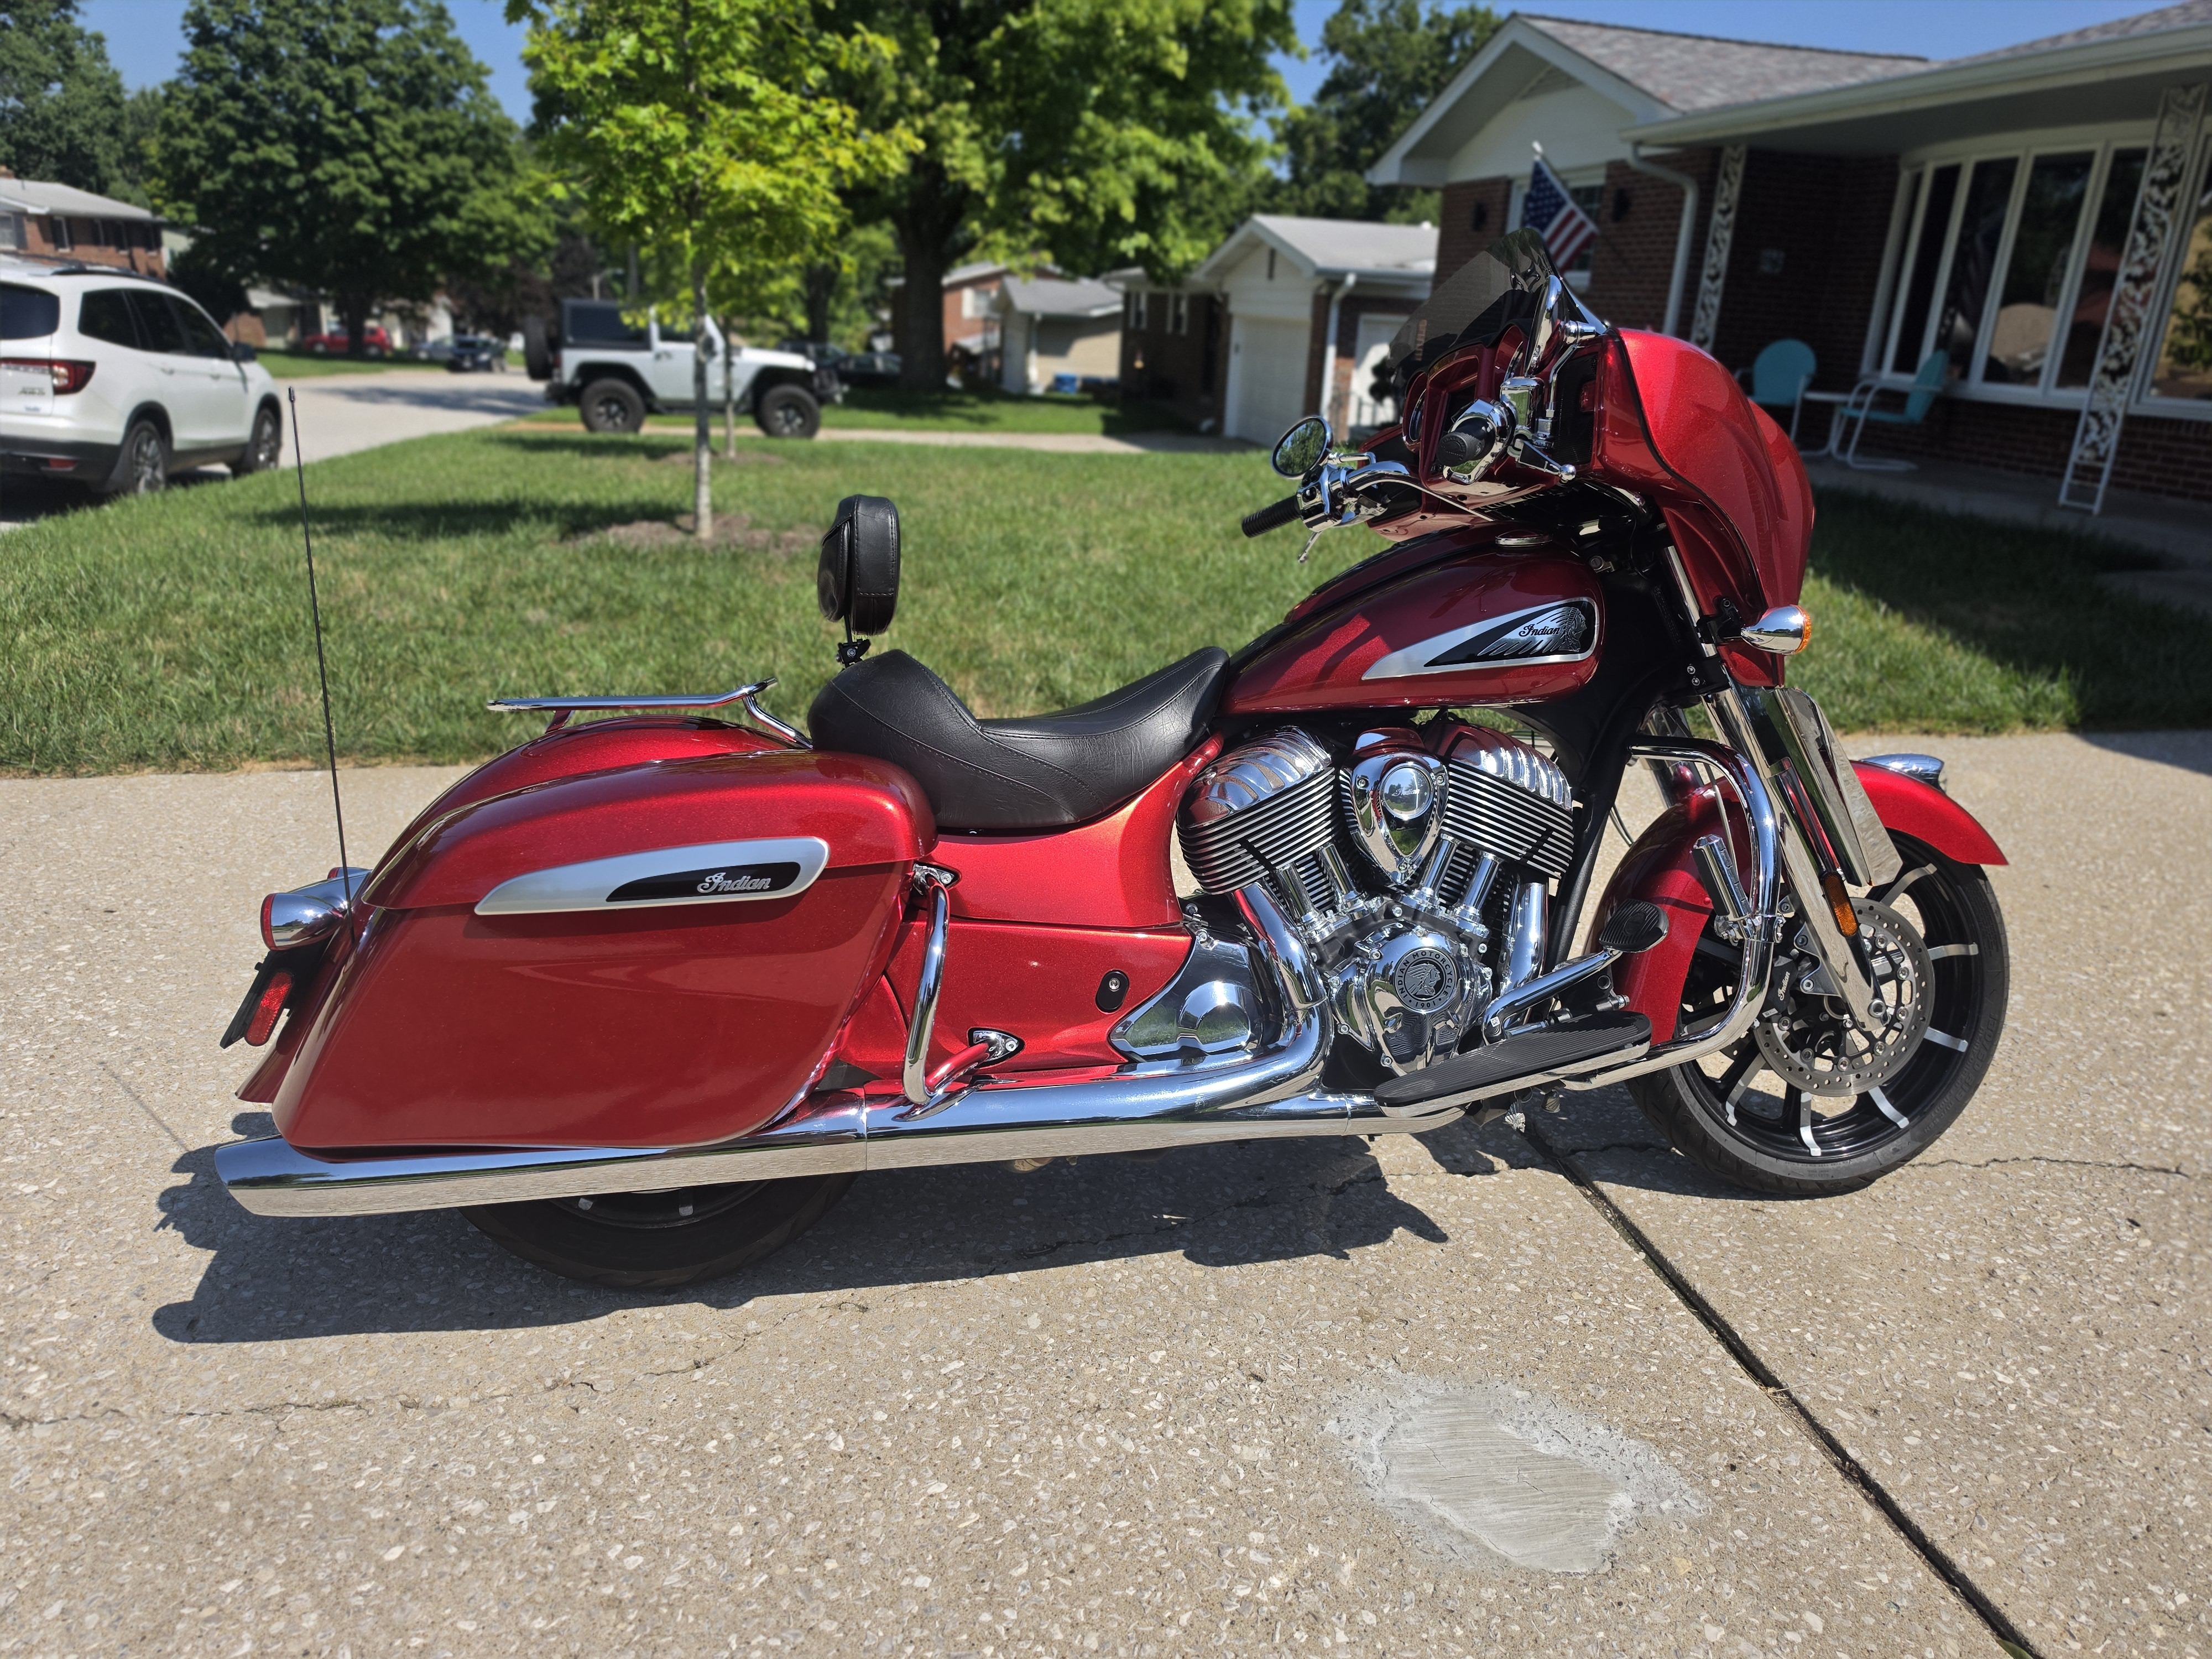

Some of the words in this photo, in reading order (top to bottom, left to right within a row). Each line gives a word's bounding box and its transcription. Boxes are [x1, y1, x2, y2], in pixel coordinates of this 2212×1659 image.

[1519, 624, 1560, 637] Indian
[697, 872, 771, 893] Indian
[1398, 959, 1410, 998] INDIAN
[1412, 951, 1453, 996] MOTORCYCLE
[1777, 971, 1791, 1000] Indian
[1671, 1066, 1717, 1134] METZEL
